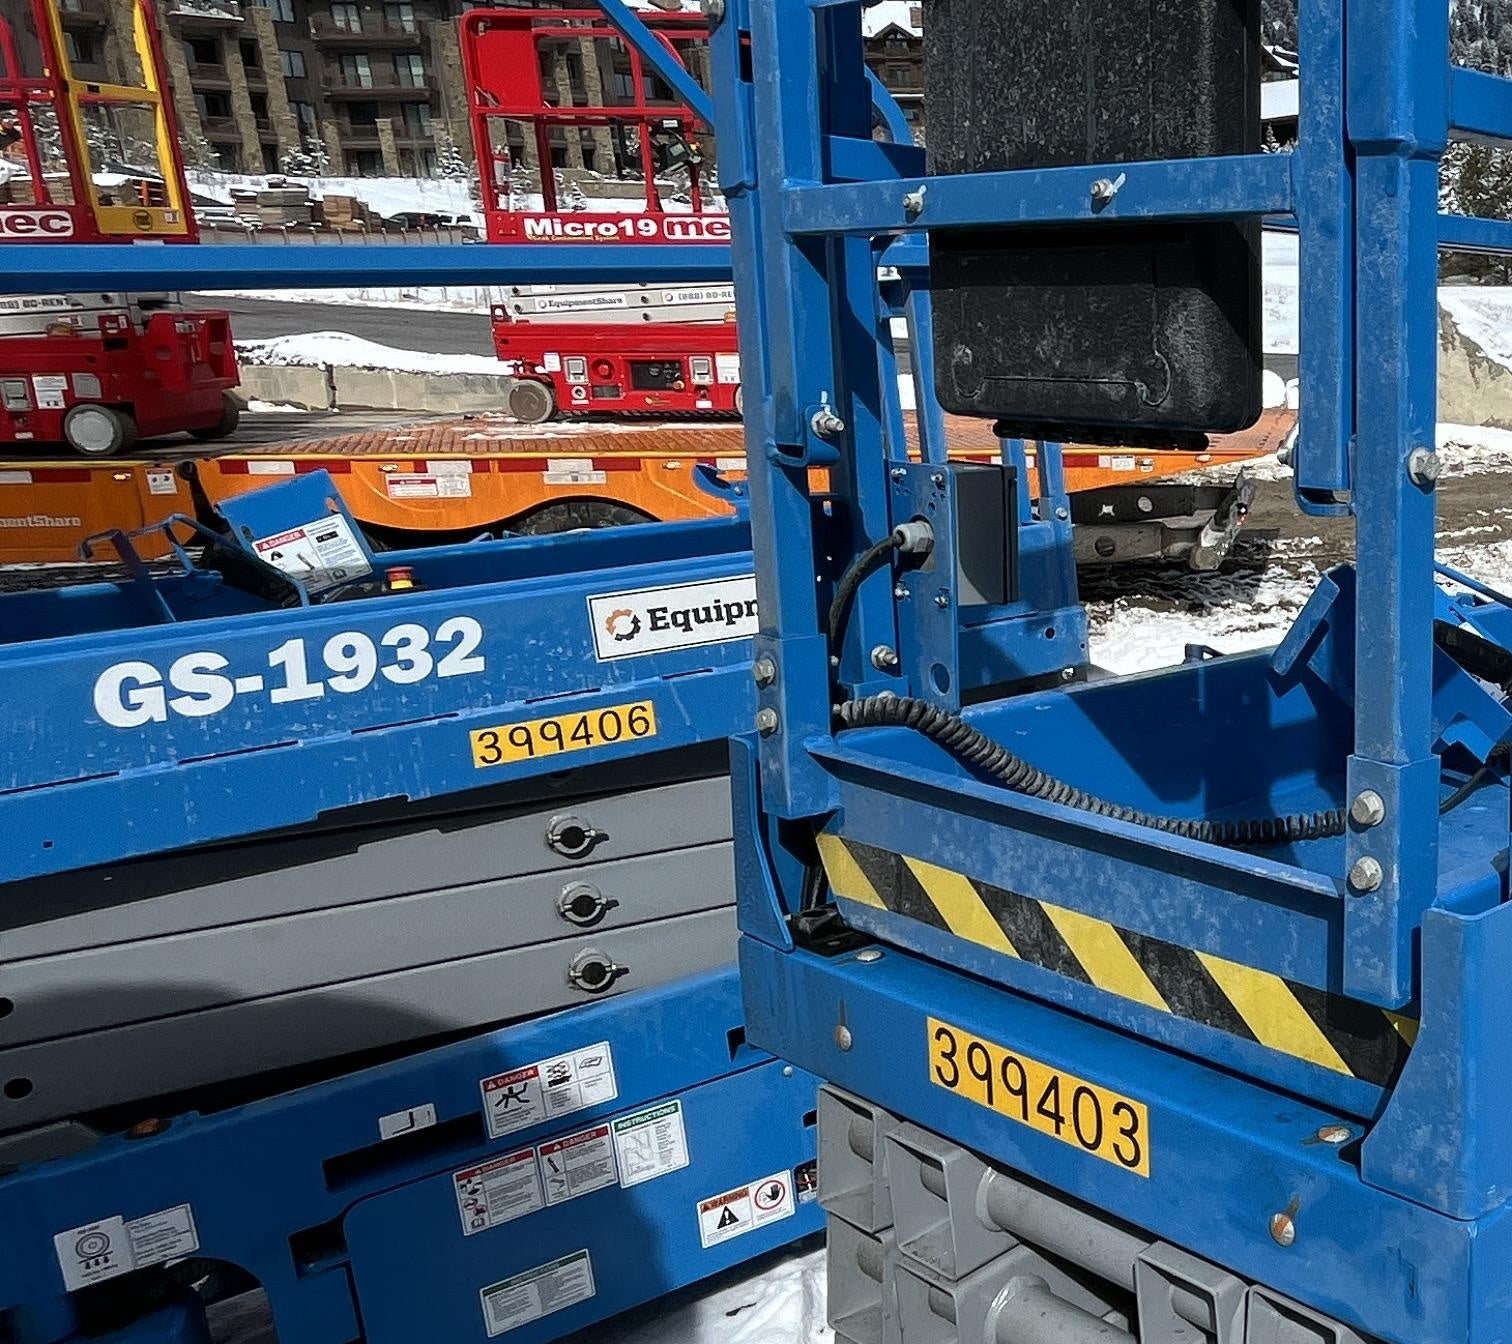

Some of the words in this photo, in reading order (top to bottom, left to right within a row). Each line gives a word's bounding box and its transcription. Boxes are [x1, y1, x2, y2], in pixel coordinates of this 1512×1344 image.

[0, 214, 71, 234] ec
[523, 218, 658, 237] Micro19
[93, 616, 486, 729] GS-1932
[477, 705, 651, 765] 399406
[934, 1027, 1141, 1168] 399403
